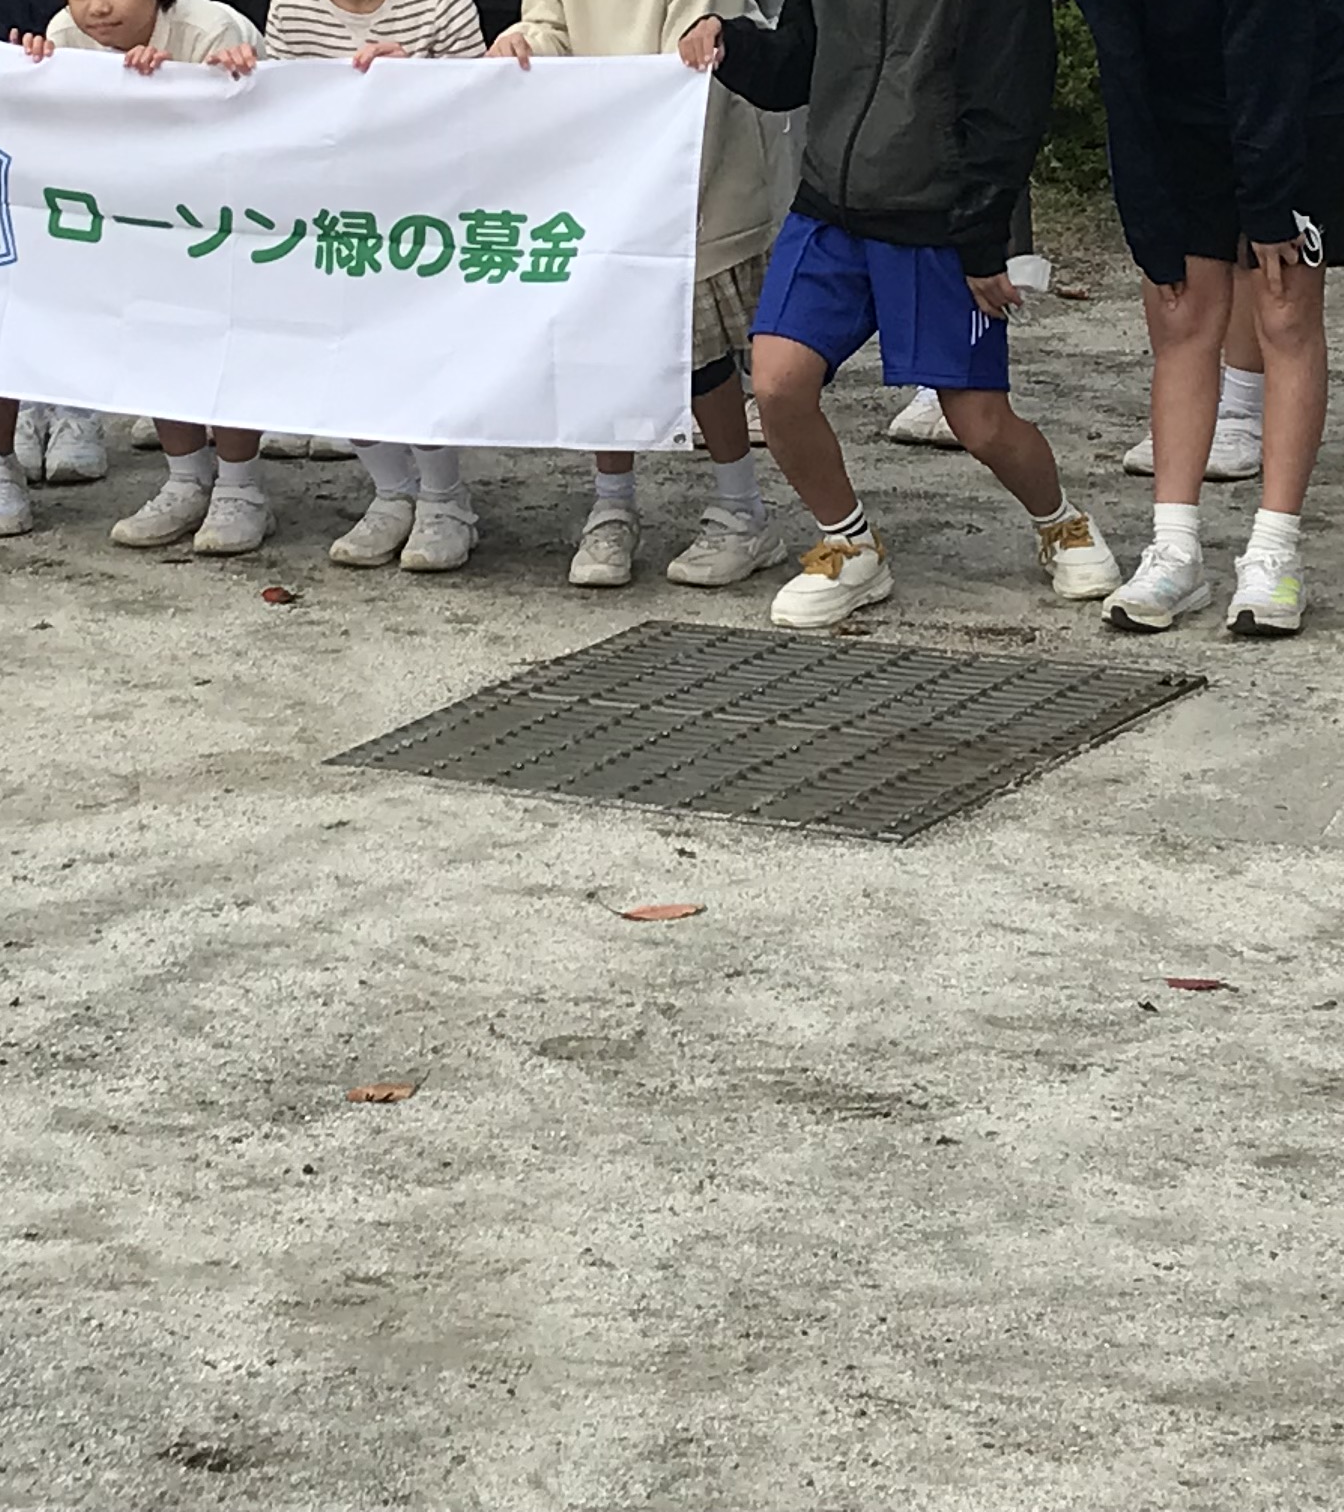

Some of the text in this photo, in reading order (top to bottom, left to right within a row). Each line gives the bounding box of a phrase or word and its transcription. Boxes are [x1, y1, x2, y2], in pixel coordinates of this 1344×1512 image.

[43, 187, 587, 285] ローソン緑の募金
